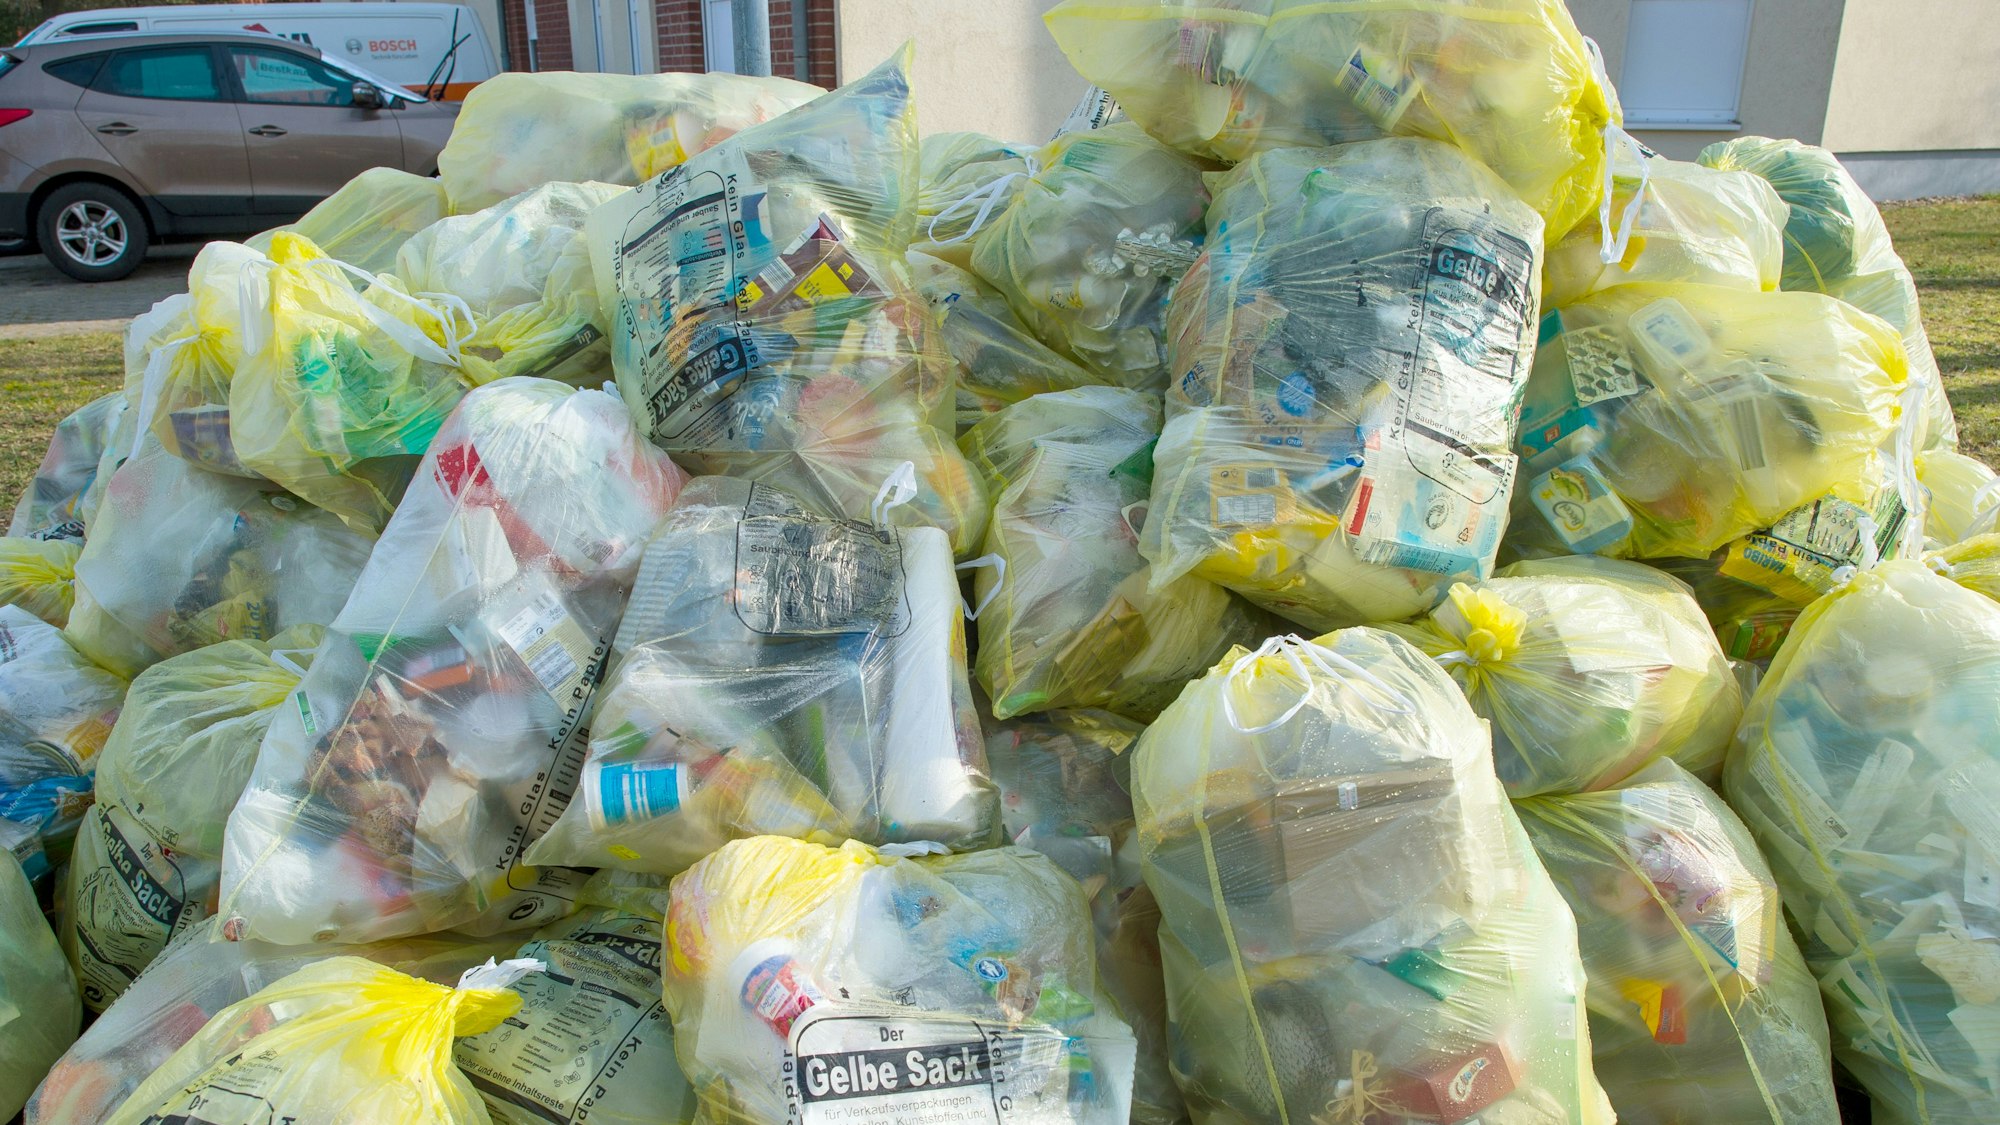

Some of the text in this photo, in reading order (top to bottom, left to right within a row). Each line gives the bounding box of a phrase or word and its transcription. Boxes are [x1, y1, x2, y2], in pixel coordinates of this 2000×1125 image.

[368, 39, 417, 52] BOSCH
[1091, 105, 1106, 130] ohne
[727, 173, 739, 213] Kein
[661, 222, 676, 235] ohne
[677, 215, 690, 226] und
[691, 204, 719, 218] Sauber
[733, 220, 745, 259] Glas
[1437, 248, 1498, 295] Gelbe
[738, 275, 749, 314] Kein
[1407, 294, 1421, 329] Kein
[686, 343, 740, 385] Gelbe
[654, 375, 688, 418] Sack
[1414, 412, 1443, 433] Sauber
[1445, 426, 1460, 438] und
[1743, 547, 1787, 574] HARIBO
[495, 636, 607, 871] Kein Glas Kein Papier
[140, 842, 154, 861] Der
[131, 869, 173, 921] Sack
[177, 900, 200, 931] Kein
[879, 1026, 904, 1043] Der
[604, 1036, 643, 1080] Kein
[805, 1047, 983, 1098] Gelbe Sack
[988, 1030, 1007, 1083] Kein
[455, 1054, 480, 1070] Sauber
[478, 1064, 492, 1076] und
[493, 1070, 512, 1085] ohne
[512, 1079, 565, 1111] Inhaltsreste
[824, 1095, 973, 1121] für Verkaufsverpackungen
[895, 1110, 963, 1125] Kunststoffen
[966, 1108, 987, 1120] und
